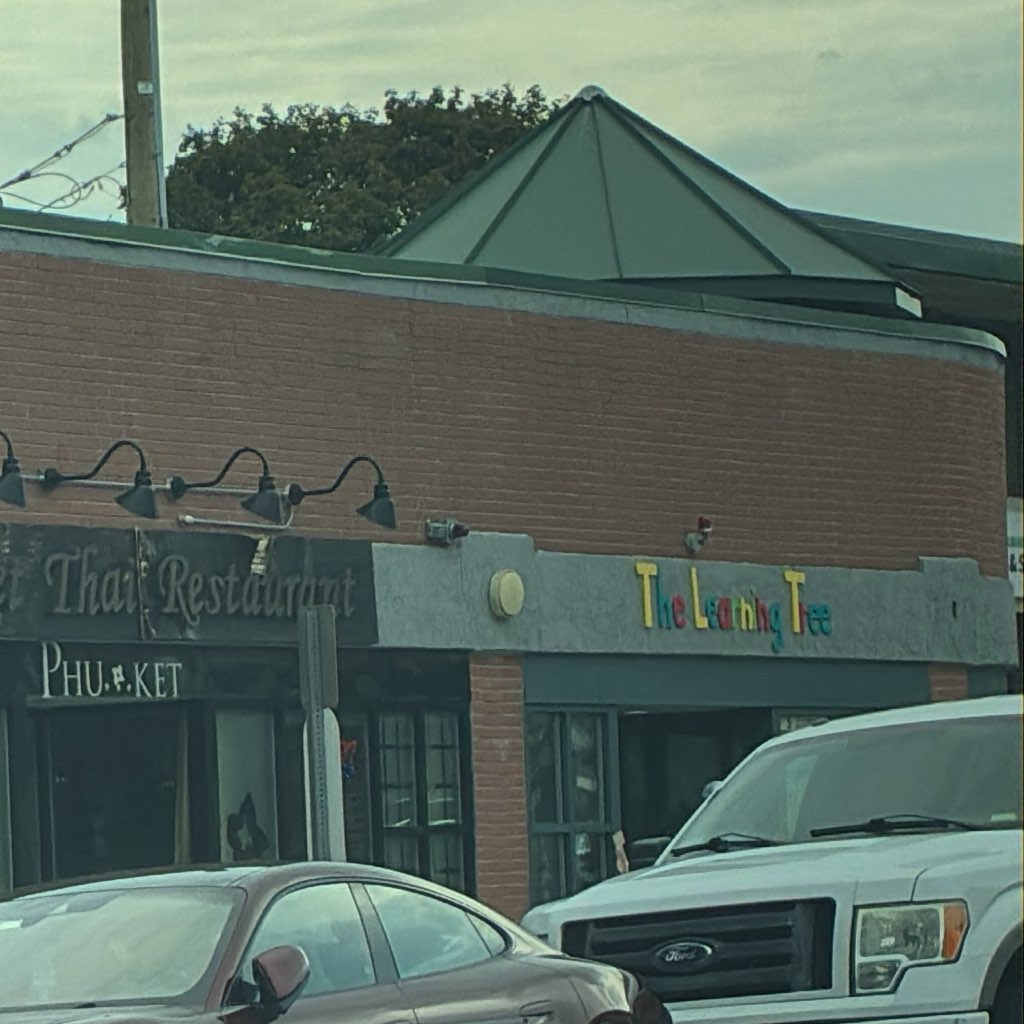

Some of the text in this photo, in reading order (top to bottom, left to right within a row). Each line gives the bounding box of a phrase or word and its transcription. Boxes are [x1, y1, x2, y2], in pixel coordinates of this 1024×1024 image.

[45, 546, 137, 615] Thai
[158, 555, 357, 627] Restaurant
[636, 562, 833, 653] The Learning Tree
[665, 948, 696, 962] Ford
